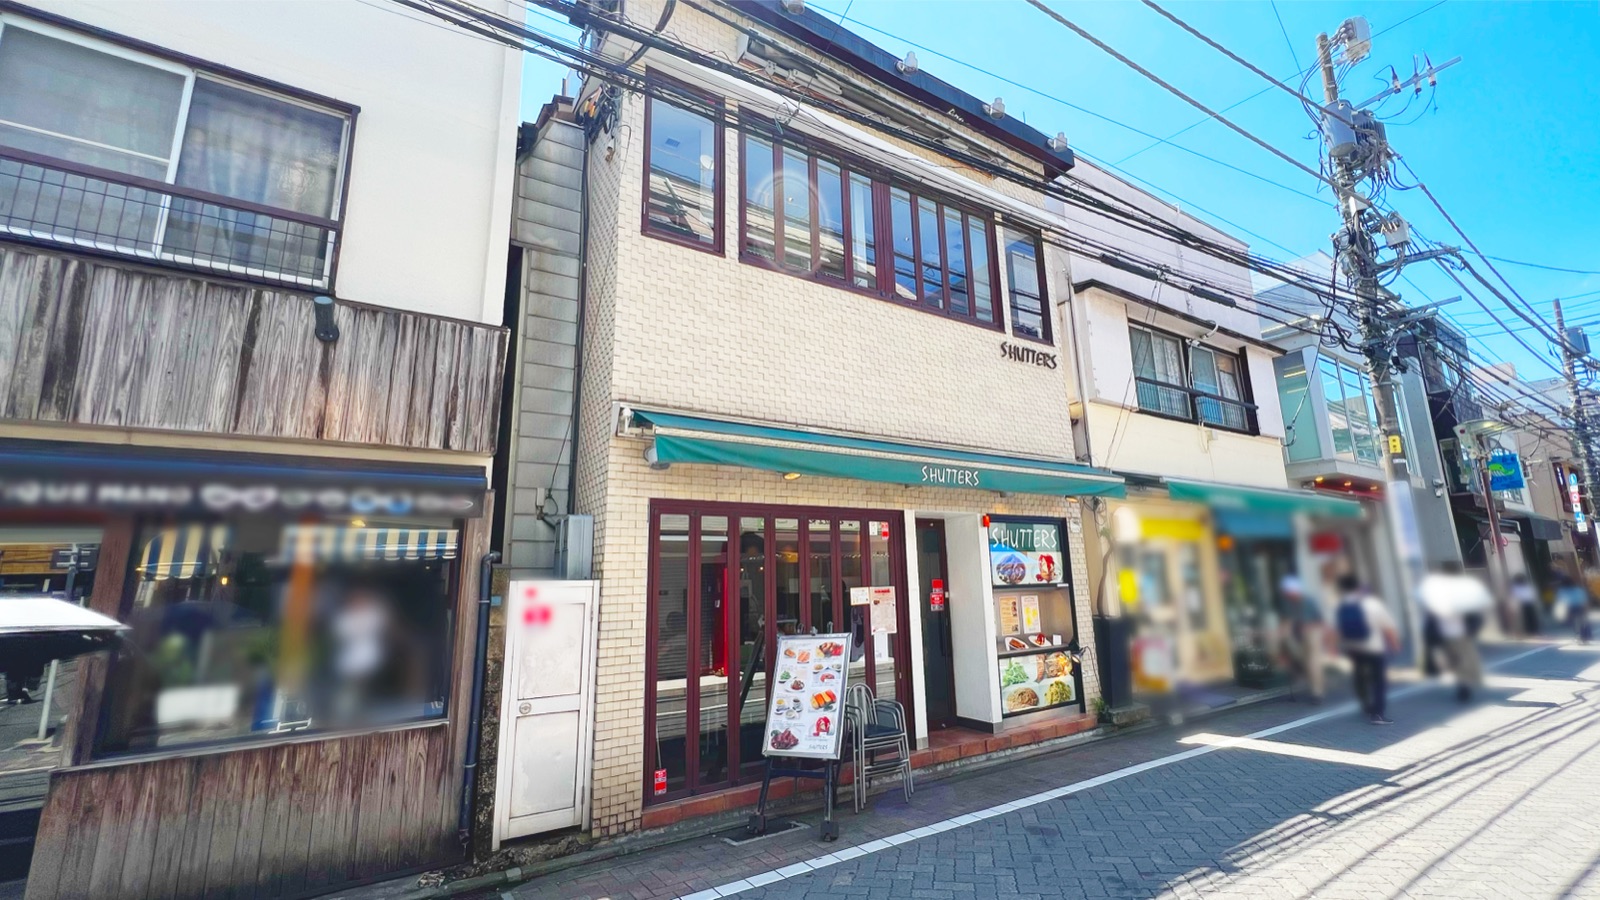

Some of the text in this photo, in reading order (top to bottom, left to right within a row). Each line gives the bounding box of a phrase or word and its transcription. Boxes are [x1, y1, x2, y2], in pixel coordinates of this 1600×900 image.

[1000, 341, 1057, 370] SHUTTERS
[921, 465, 979, 487] SHUTTERS
[992, 527, 1057, 550] SHUTTERS
